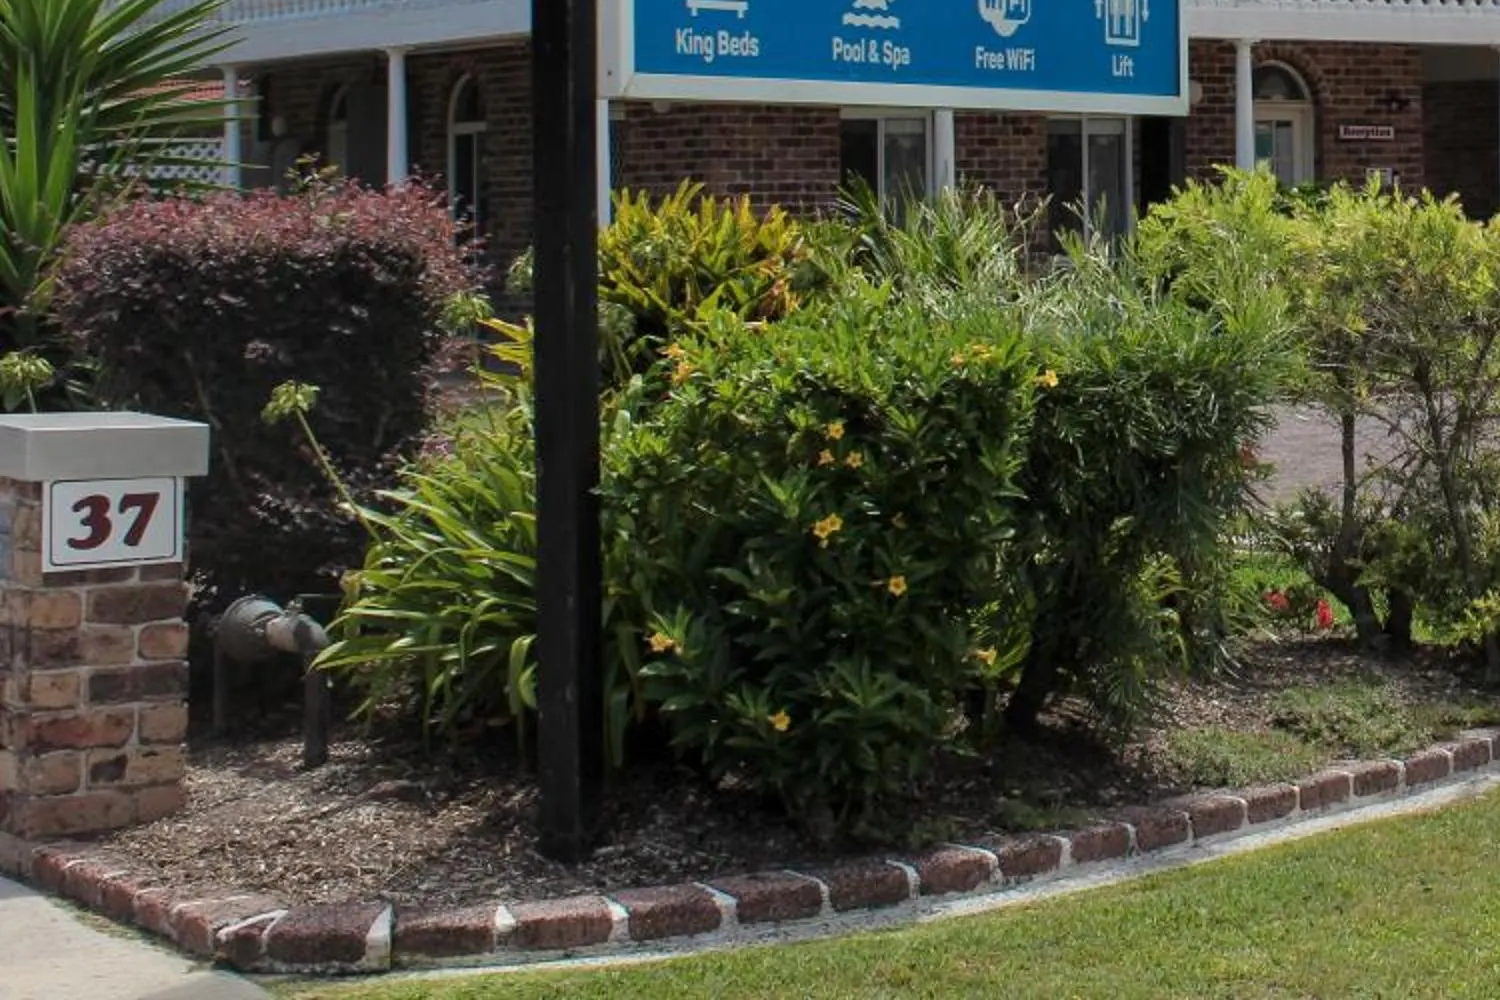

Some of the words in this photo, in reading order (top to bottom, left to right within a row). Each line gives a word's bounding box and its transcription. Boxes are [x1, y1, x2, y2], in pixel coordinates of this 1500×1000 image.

[675, 27, 713, 63] King
[716, 30, 760, 57] Beds
[831, 36, 866, 62] Pool
[867, 39, 881, 63] &
[883, 40, 911, 70] Spa
[975, 46, 1005, 70] Free
[1006, 48, 1036, 72] WiFi
[1112, 54, 1135, 78] Lift
[66, 491, 161, 551] 37
